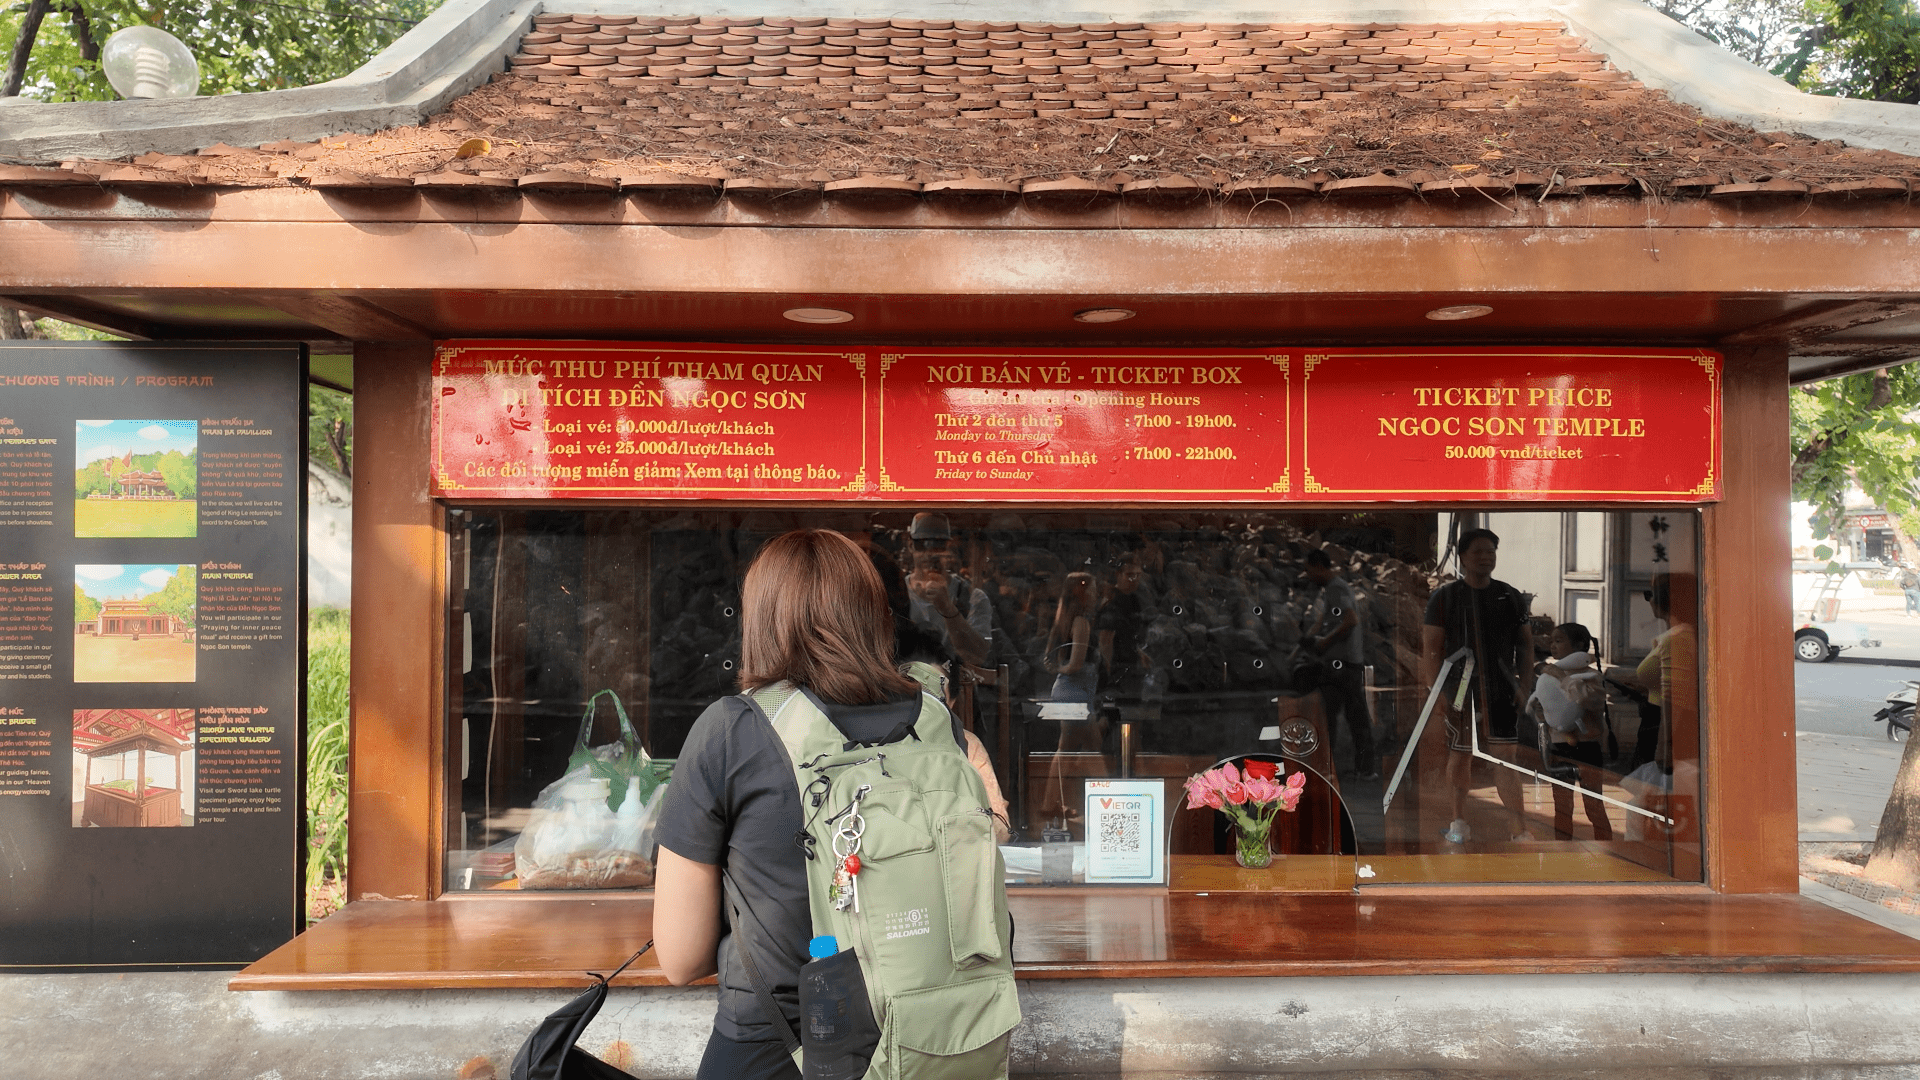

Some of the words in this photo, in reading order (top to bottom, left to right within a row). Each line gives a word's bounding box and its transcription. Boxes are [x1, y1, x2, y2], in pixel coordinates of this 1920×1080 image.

[484, 355, 543, 378] MỨC
[551, 360, 606, 378] THU
[614, 356, 660, 379] PHÍ
[668, 361, 744, 381] THAM
[752, 363, 823, 385] QUAN
[927, 363, 973, 383] NƠI
[980, 361, 1030, 384] BÁN
[1037, 361, 1071, 384] VÉ
[1091, 366, 1184, 384] TICKET
[1191, 366, 1242, 384] BOX
[66, 372, 115, 386] TRÌNH
[136, 375, 214, 387] PROGRAM
[501, 388, 530, 406] DI
[539, 383, 601, 407] TÍCH
[609, 381, 664, 407] ĐỀN
[672, 390, 747, 413] NGỌC
[754, 389, 806, 410] SƠN
[1075, 392, 1145, 409] Opening
[1149, 392, 1201, 406] Hours
[1413, 387, 1520, 407] TICKET
[1528, 387, 1612, 407] PRICE
[543, 419, 581, 438] Loại
[586, 419, 612, 433] vé:
[934, 413, 969, 427] Thứ
[972, 414, 982, 427] 2
[986, 413, 1016, 427] đến
[1020, 413, 1050, 427] thứ
[1054, 414, 1063, 427] 5
[1134, 414, 1172, 428] 7h00
[1186, 414, 1237, 428] 19h00.
[1378, 417, 1460, 436] NGOC
[1468, 417, 1525, 436] SON
[1534, 417, 1645, 437] TEMPLE
[935, 430, 981, 442] Monday
[985, 431, 996, 441] to
[1000, 430, 1054, 442] Thursday
[543, 440, 581, 458] Loại
[586, 440, 612, 454] vé:
[934, 450, 969, 464] Thứ
[972, 451, 982, 464] 6
[986, 450, 1016, 464] đến
[1021, 450, 1054, 464] Chủ
[1060, 451, 1098, 468] nhật
[1134, 447, 1172, 460] 7h00
[1185, 447, 1237, 460] 22h00.
[1445, 445, 1495, 459] 50.000
[464, 461, 496, 478] Các
[500, 459, 527, 478] đối
[532, 464, 582, 481] tượng
[586, 458, 629, 478] miễn
[634, 461, 680, 481] giảm:
[684, 462, 723, 479] Xem
[726, 463, 749, 483] tại
[753, 464, 803, 482] thông
[807, 464, 841, 480] báo.
[934, 468, 973, 481] Friday
[975, 470, 987, 479] to
[989, 469, 1034, 481] Sunday
[1100, 798, 1141, 810] VIETQR
[886, 927, 930, 940] SALOMON
